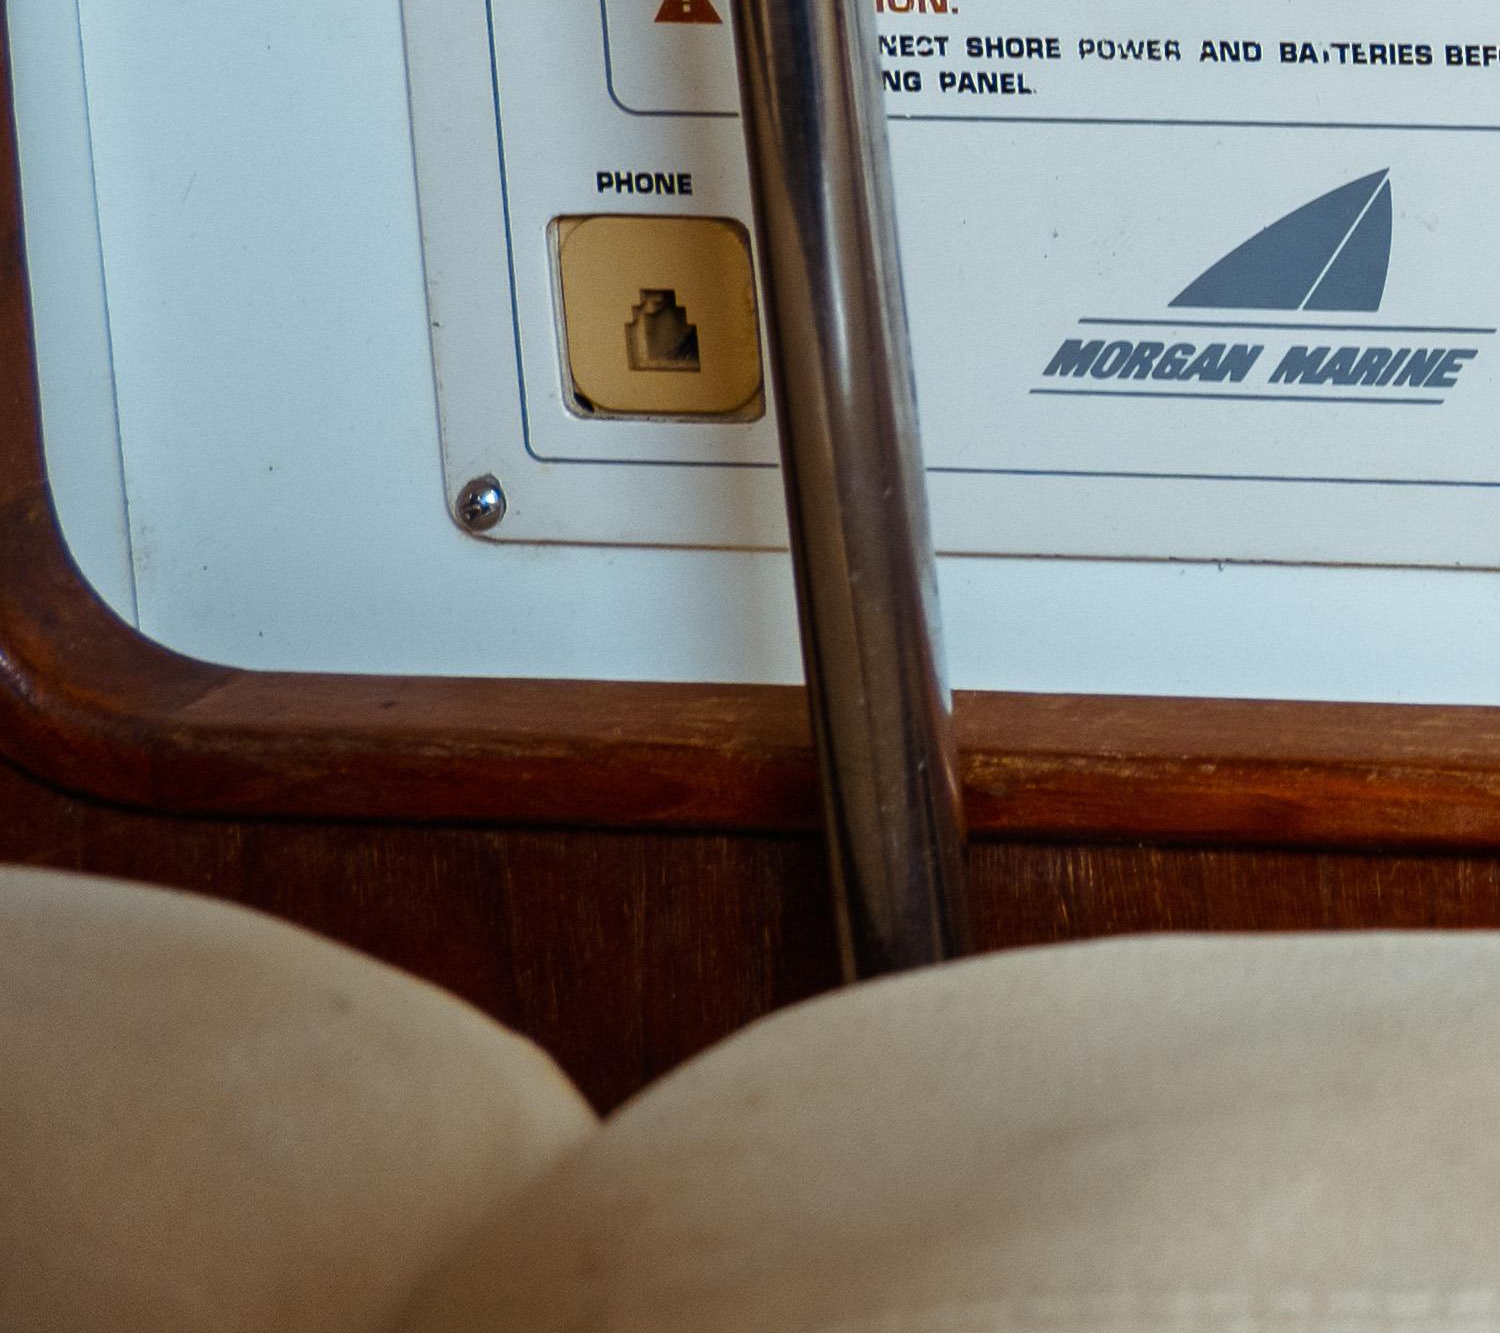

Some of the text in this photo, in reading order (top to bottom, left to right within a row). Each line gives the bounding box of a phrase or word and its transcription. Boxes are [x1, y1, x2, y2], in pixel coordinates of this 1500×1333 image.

[965, 36, 1062, 59] SHORE
[1078, 38, 1181, 61] POWER
[1199, 40, 1262, 62] AND
[596, 171, 693, 196] PHONE
[1042, 339, 1479, 389] MORGAN MARINE
